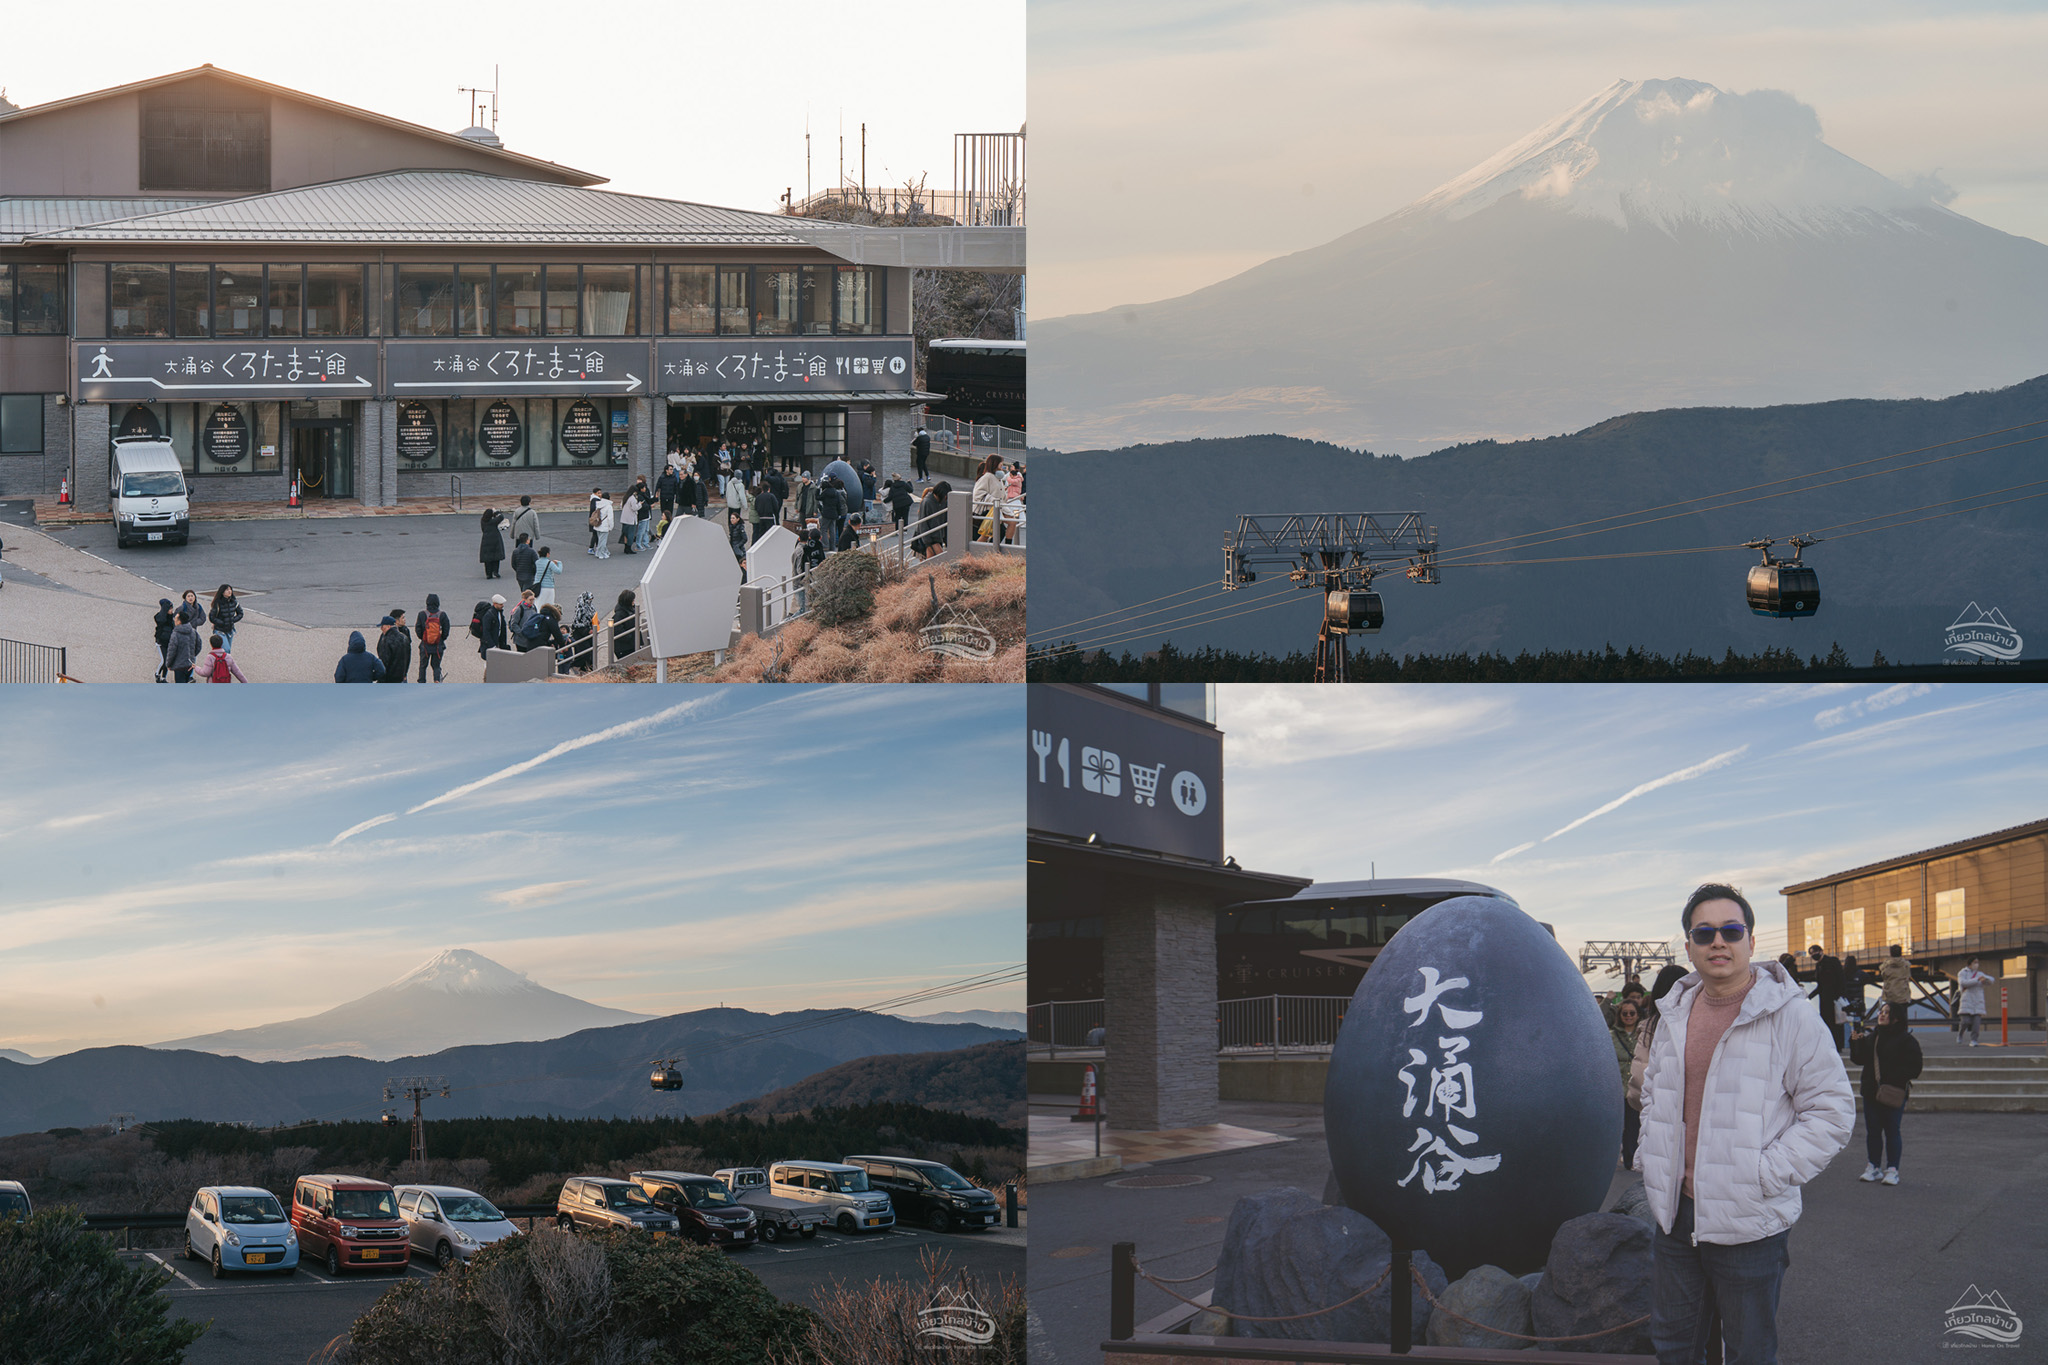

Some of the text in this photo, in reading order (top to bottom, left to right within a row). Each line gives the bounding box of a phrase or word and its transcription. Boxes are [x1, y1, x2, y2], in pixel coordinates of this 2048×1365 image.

[165, 347, 347, 382] 大涌谷 くろたまご館
[433, 345, 605, 379] 大涌谷 くろたまご館
[664, 350, 828, 382] 大涌谷 くろたまご館
[985, 391, 1026, 401] CRYSTAL
[1266, 965, 1346, 980] CRUISER
[1398, 966, 1502, 1194] 大涌谷
